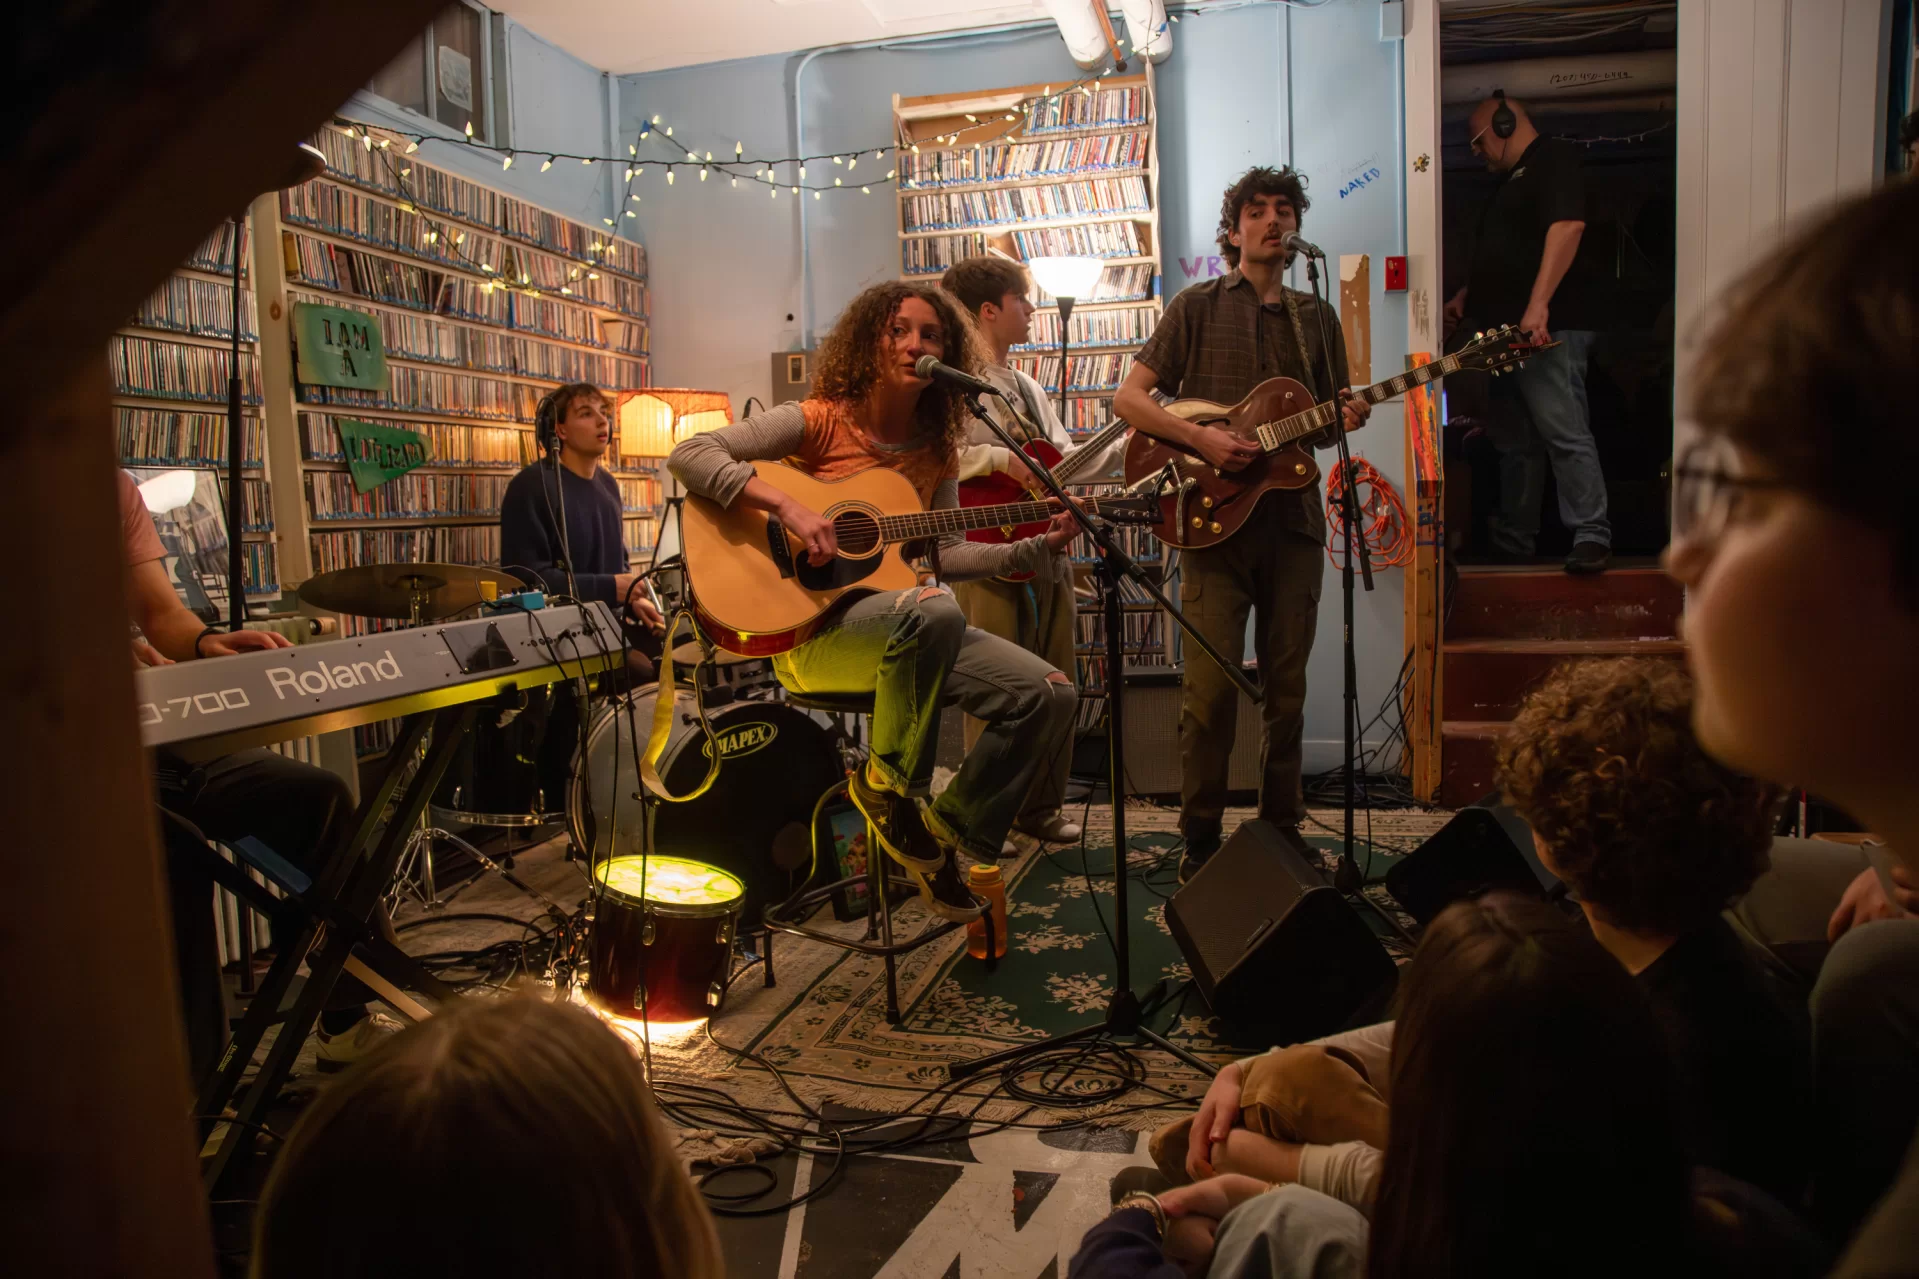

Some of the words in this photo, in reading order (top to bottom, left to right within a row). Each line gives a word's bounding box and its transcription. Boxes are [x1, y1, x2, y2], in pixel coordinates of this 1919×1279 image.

[1339, 167, 1380, 199] NAKED
[322, 318, 334, 346] I
[337, 321, 371, 351] AM
[339, 349, 359, 377] A
[265, 650, 404, 700] Roland
[718, 725, 766, 755] MAPEX
